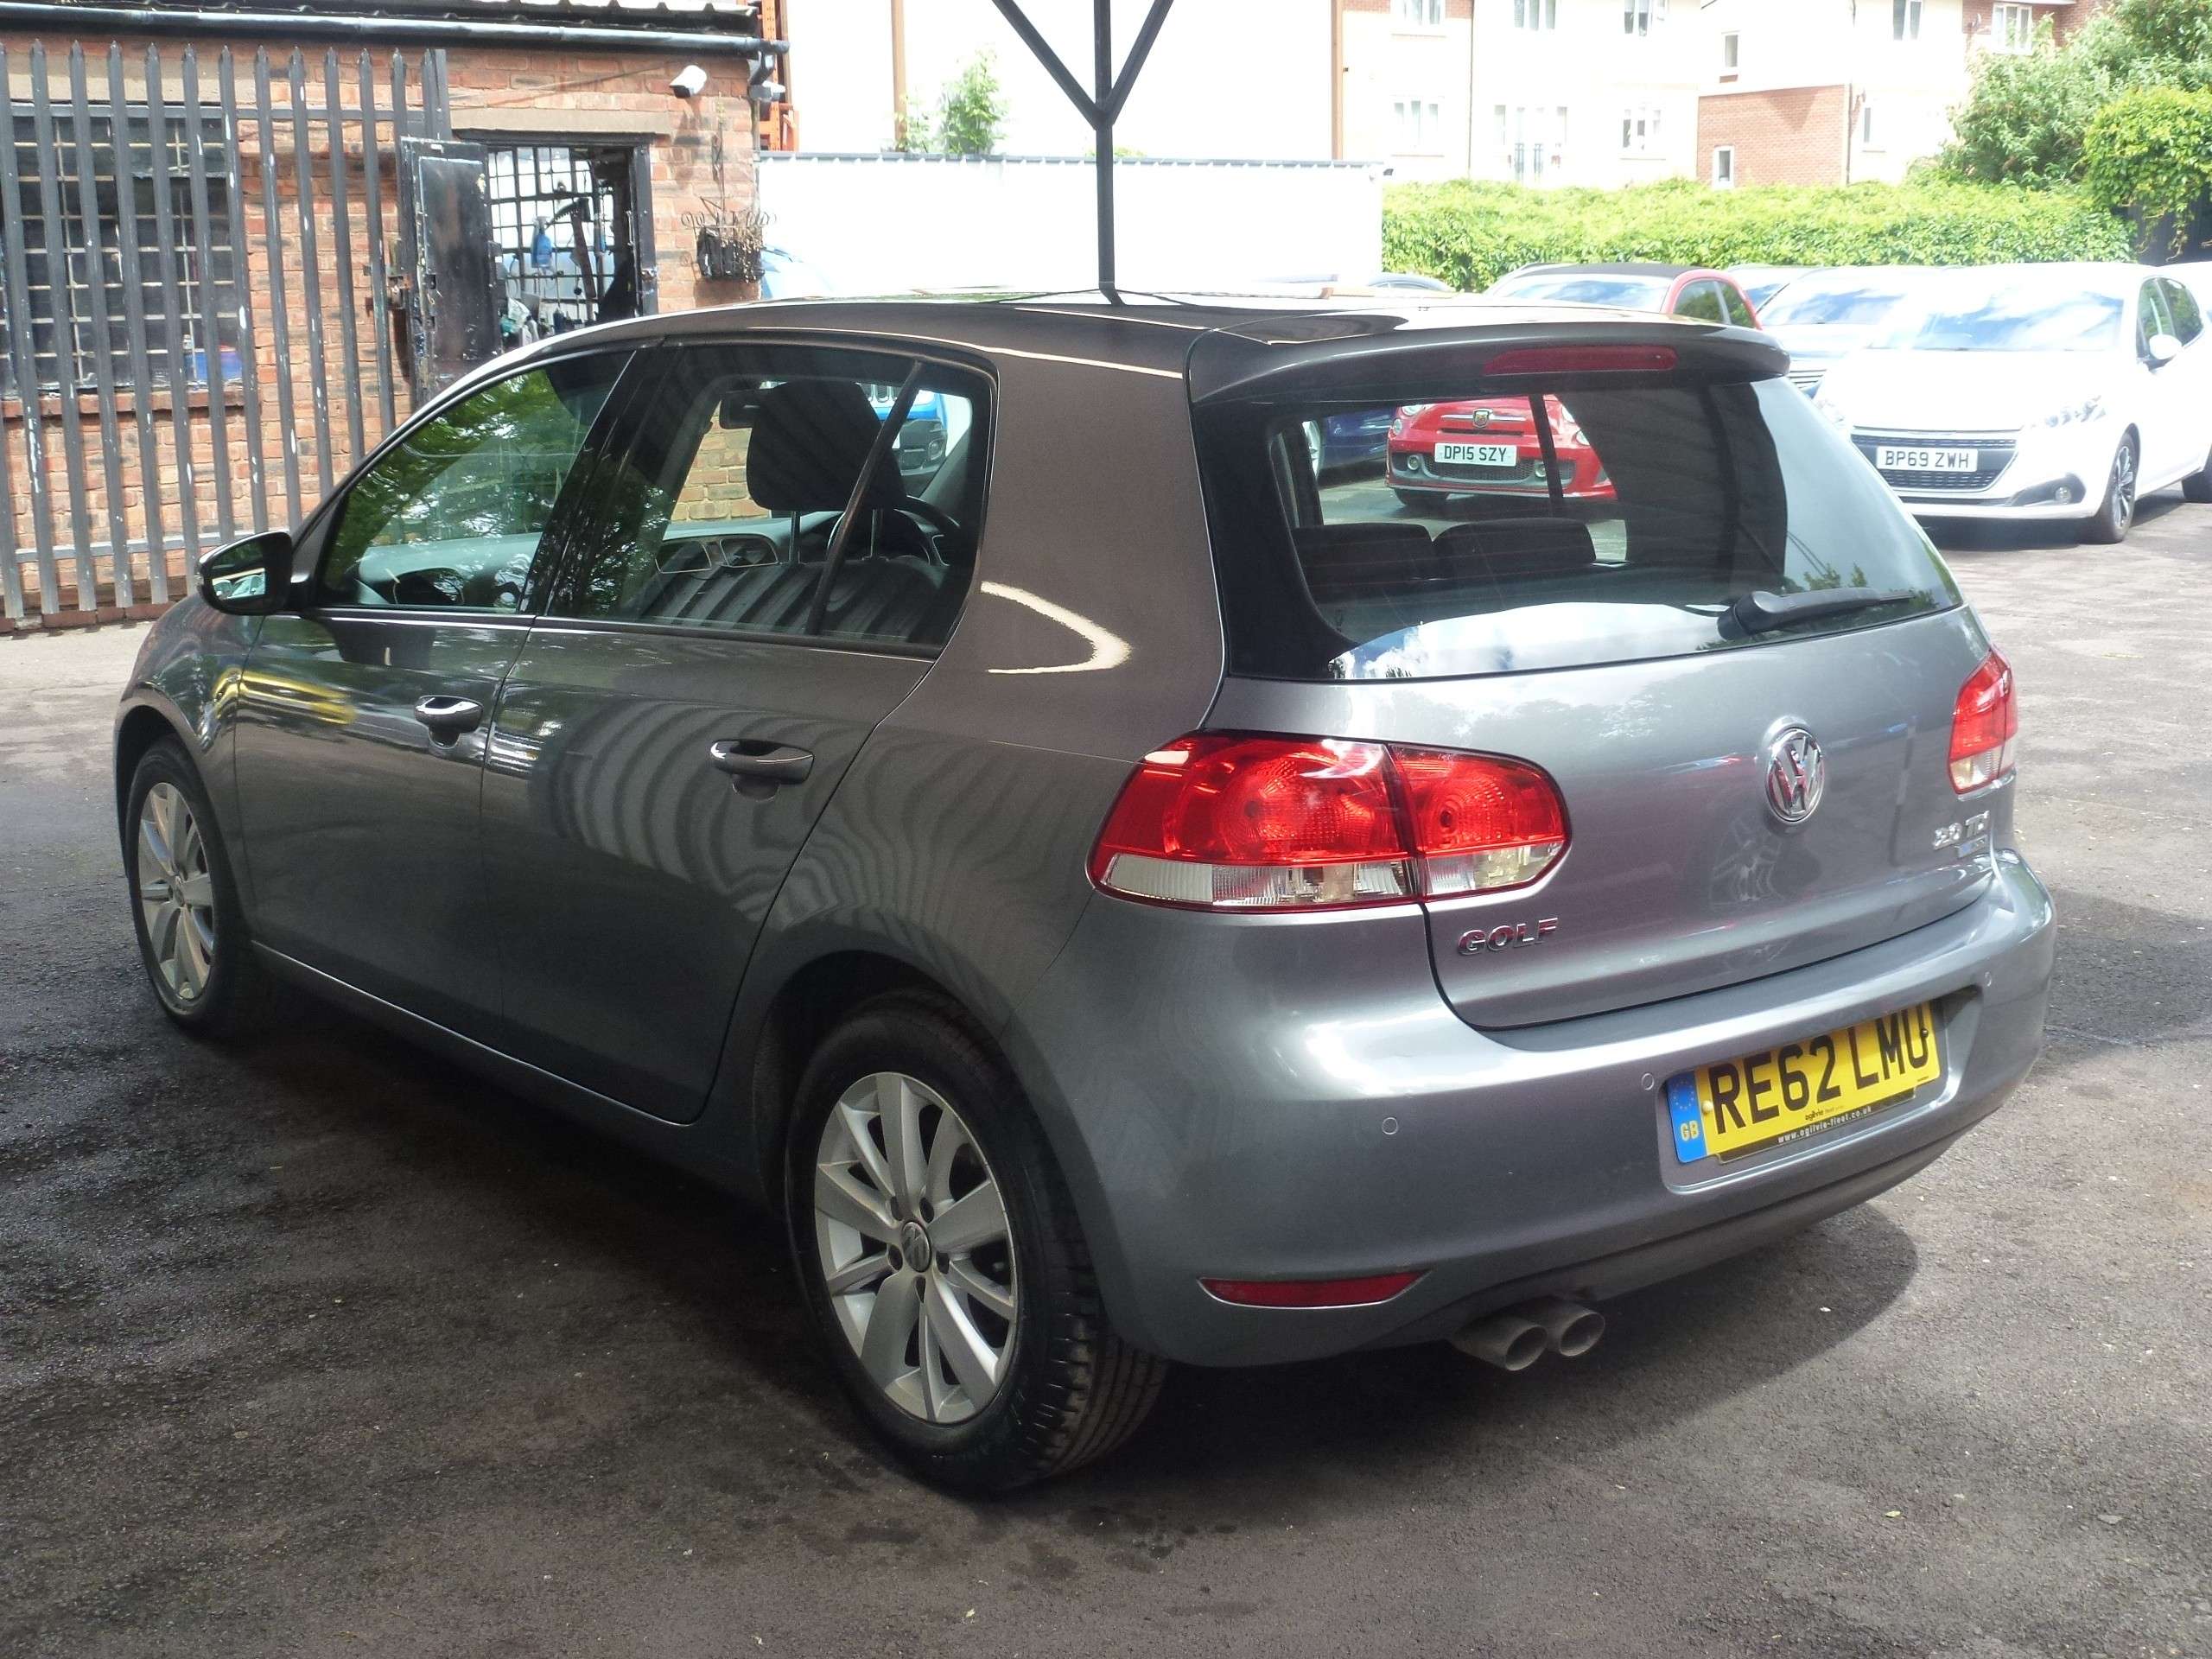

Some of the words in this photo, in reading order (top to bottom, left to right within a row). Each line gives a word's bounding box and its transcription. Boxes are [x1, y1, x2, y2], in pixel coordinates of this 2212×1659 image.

[1444, 445, 1474, 461] DP15
[1478, 447, 1507, 462] SZY
[1885, 450, 1929, 467] BP69
[1935, 452, 1968, 468] ZWH
[1458, 917, 1558, 956] GOLF
[1707, 1035, 1841, 1135] RE62
[1847, 1007, 1929, 1090] LMU
[1680, 1121, 1700, 1141] GB
[1777, 1106, 1872, 1143] www.ogilvie-fleet.co.uk
